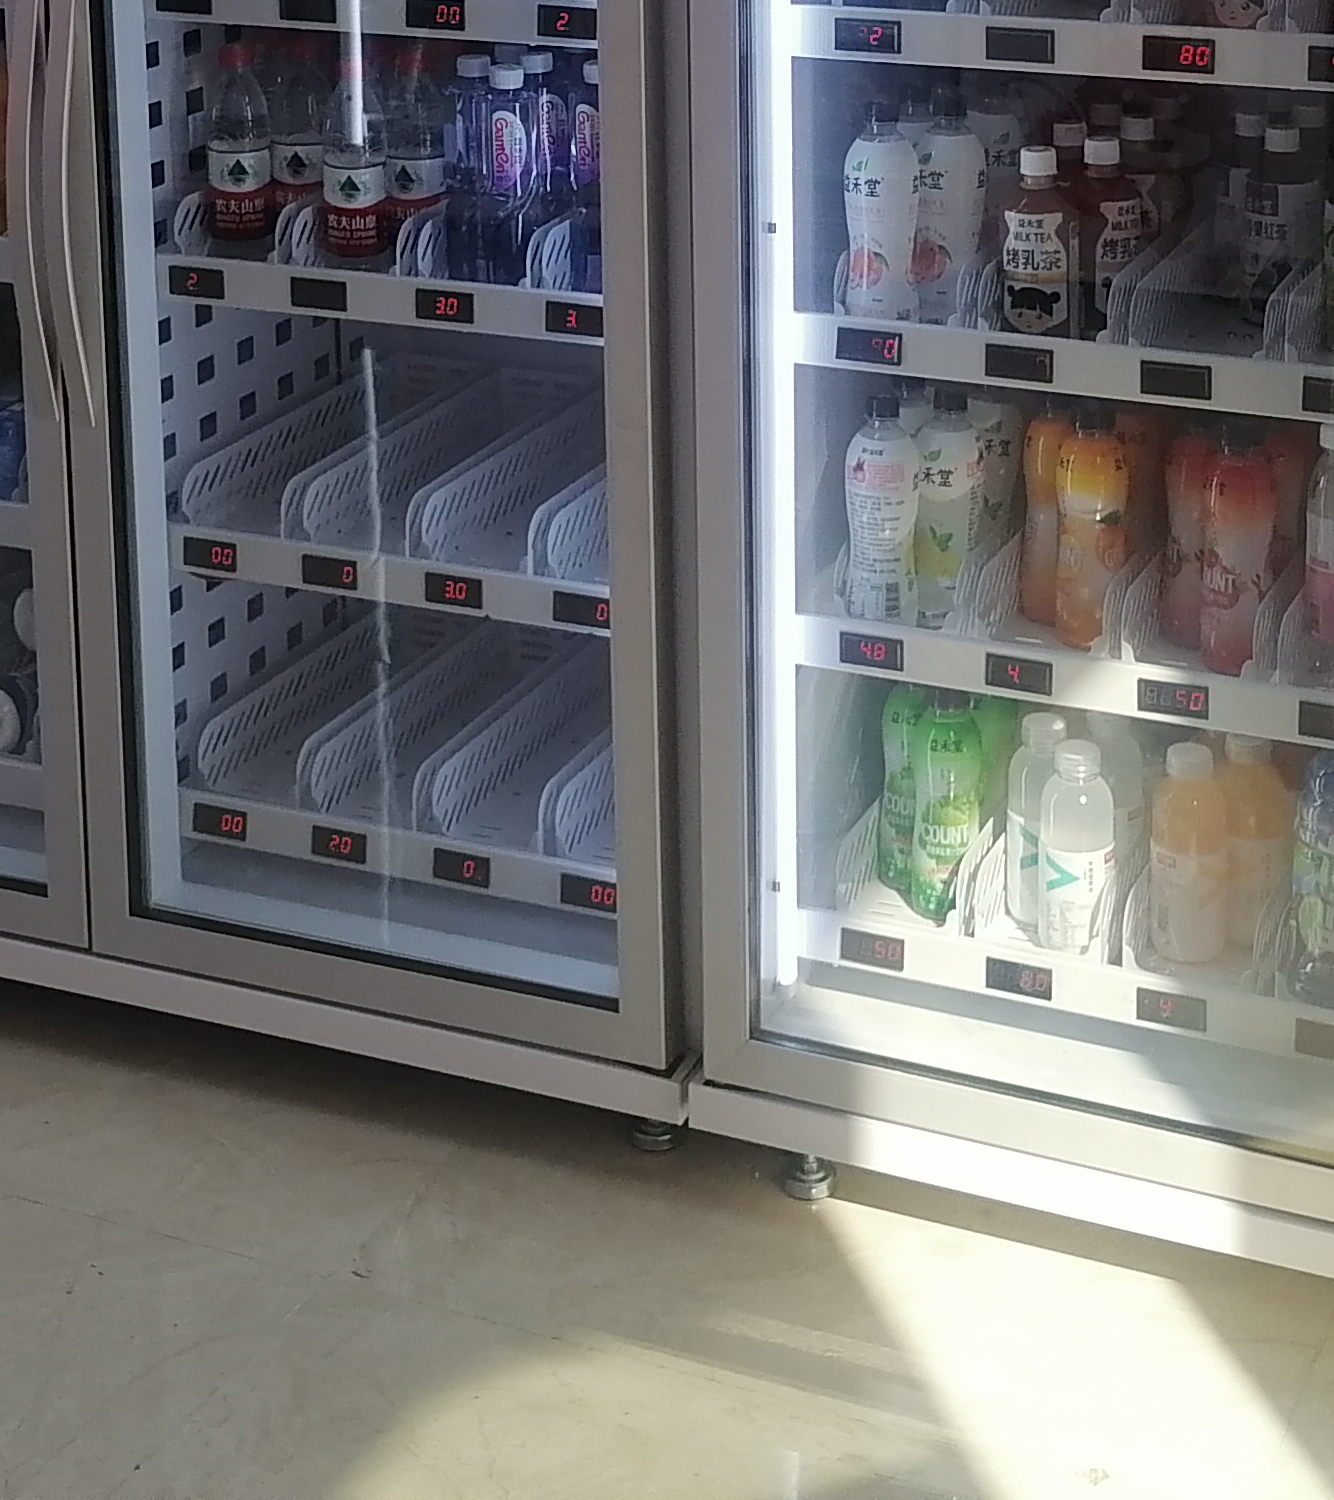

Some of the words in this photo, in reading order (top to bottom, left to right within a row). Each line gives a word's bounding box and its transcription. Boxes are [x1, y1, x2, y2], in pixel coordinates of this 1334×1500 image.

[1032, 231, 1052, 243] TEA
[1005, 250, 1061, 272] 烤乳茶
[913, 467, 954, 489] 禾堂
[922, 825, 969, 845] COUNT
